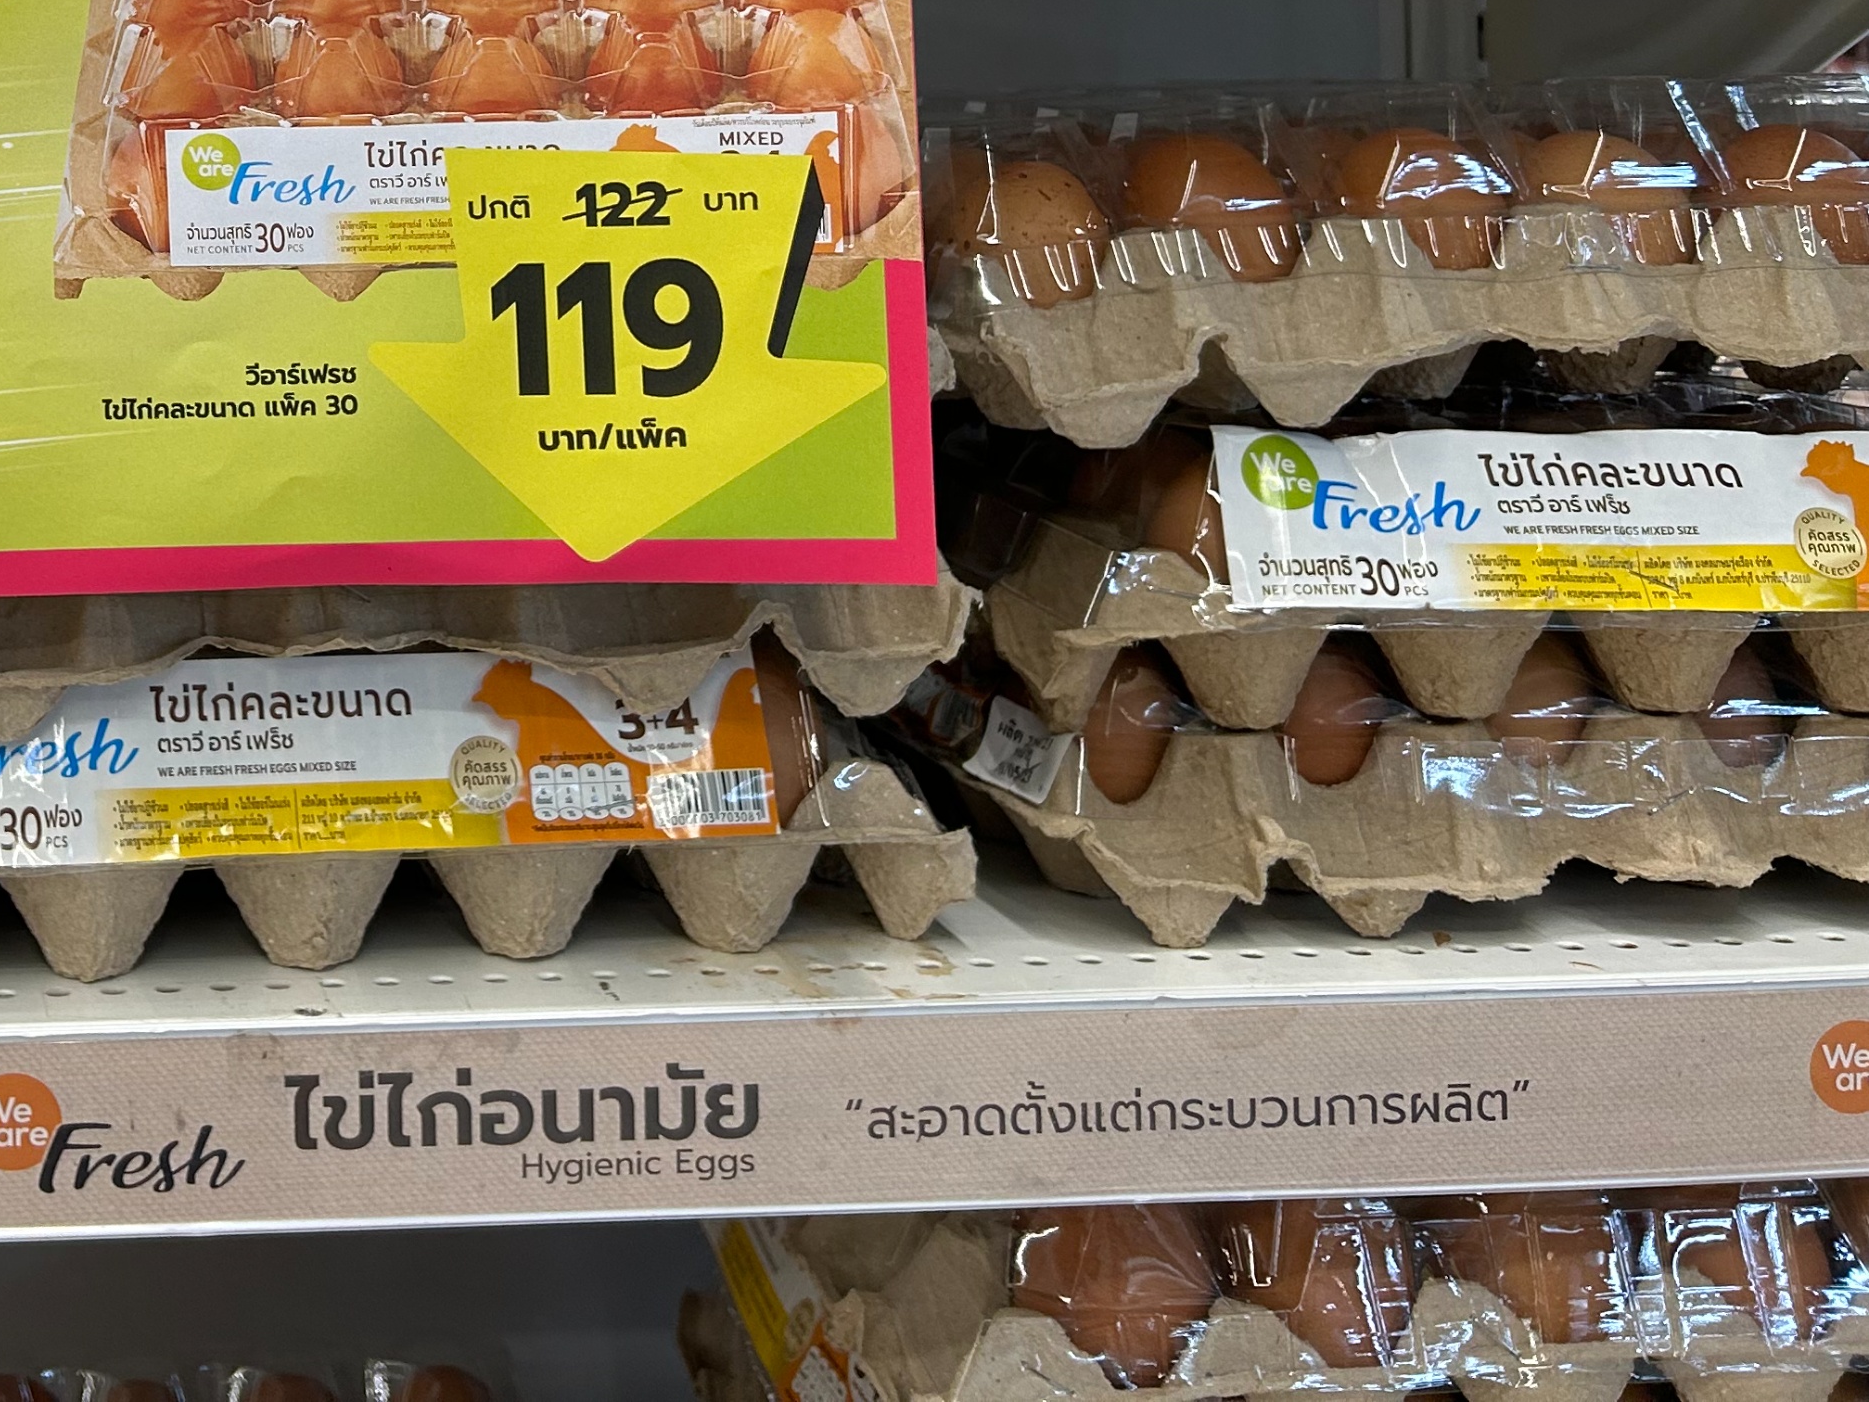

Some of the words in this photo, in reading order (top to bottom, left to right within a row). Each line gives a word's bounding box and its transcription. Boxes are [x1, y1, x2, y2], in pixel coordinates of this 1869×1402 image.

[719, 131, 783, 146] MIXED
[188, 146, 223, 164] We
[199, 163, 233, 178] are
[229, 159, 356, 205] Fresh
[467, 193, 531, 219] ปกติ
[562, 182, 682, 228] 122
[703, 188, 758, 213] บาท
[186, 222, 253, 245] จำนวนสุทธิ
[254, 222, 284, 253] 30
[286, 223, 314, 239] ฟอง
[491, 258, 724, 398] 119
[245, 361, 358, 387] วีอาร์เฟรช
[102, 397, 255, 423] ไข่ไก่คละขนาด
[265, 394, 317, 418] แพ็ค
[325, 394, 358, 417] 30
[538, 421, 687, 451] บาท/แพ็ค
[1249, 452, 1296, 475] We
[1478, 452, 1742, 489] ไข่ไก่คละขนาด
[1312, 479, 1481, 535] Fresh
[1498, 493, 1544, 515] ตราวี
[1549, 493, 1582, 515] อาร์
[1504, 525, 1520, 536] WE
[1524, 525, 1542, 536] ARE
[1545, 525, 1578, 535] FRESH
[1580, 525, 1612, 535] FRESH
[1614, 525, 1639, 535] EGGS
[1642, 525, 1673, 535] MIXED
[1676, 525, 1699, 535] SIZE
[1259, 556, 1352, 582] จำนวนสุทธิ
[1357, 557, 1399, 596] 30
[1400, 559, 1438, 579] ฟอง
[150, 683, 412, 723] ไข่ไก่คละขนาด
[157, 731, 204, 753] ตราวี
[209, 731, 240, 752] อาร์
[285, 1063, 760, 1150] ไข่ไก่อนามัย
[38, 1121, 244, 1194] Fresh
[521, 1149, 661, 1183] Hygienic
[674, 1149, 755, 1180] Eggs
